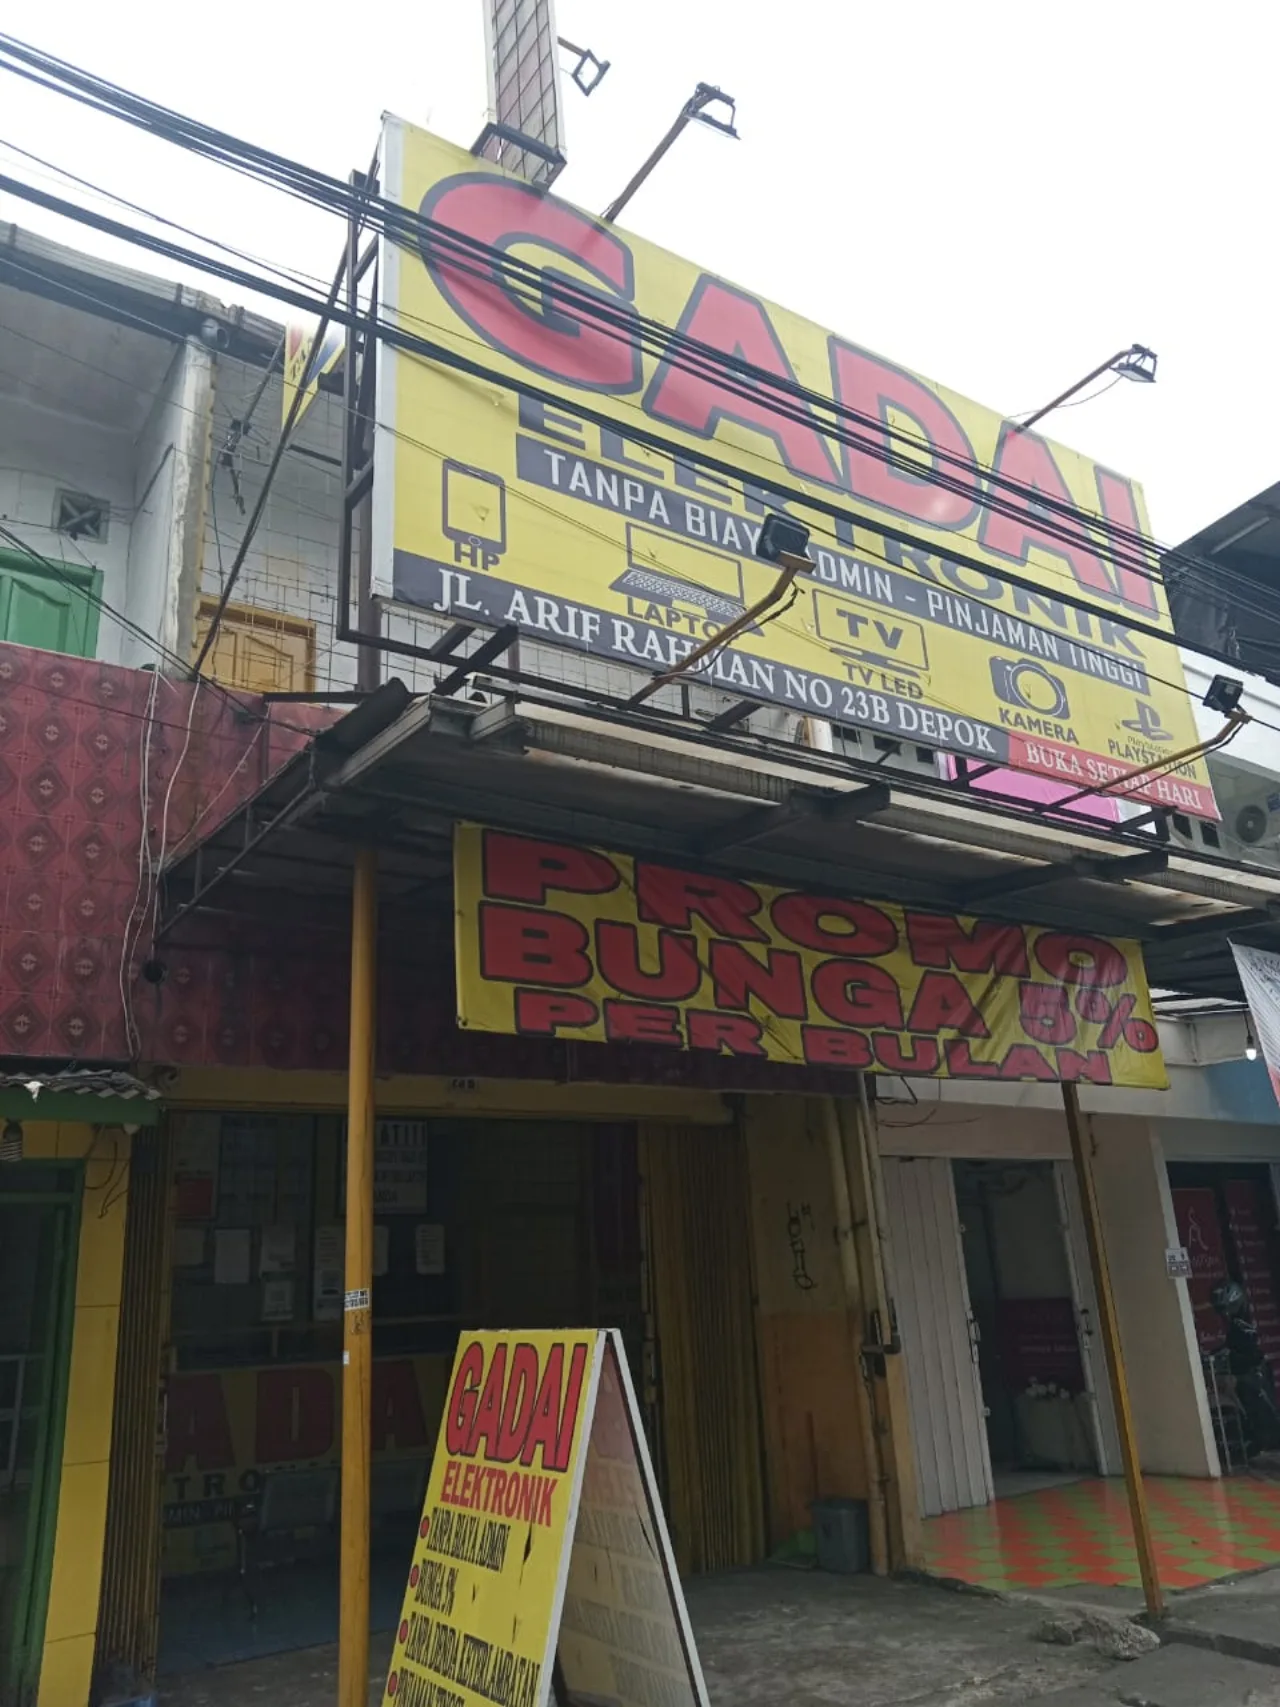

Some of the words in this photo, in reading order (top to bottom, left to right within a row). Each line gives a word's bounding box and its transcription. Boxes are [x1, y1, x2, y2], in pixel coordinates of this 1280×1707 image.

[419, 172, 1159, 620] GADAI
[453, 542, 501, 571] HP
[543, 449, 671, 525] TANPA
[684, 501, 764, 557] BIAY
[804, 547, 893, 603] DMIN
[926, 588, 1059, 661] PINJAMAN
[1068, 643, 1144, 689] TINGGI
[433, 568, 489, 616] JL.
[504, 589, 601, 643] ARIF
[611, 618, 776, 694] RAHMAN
[783, 669, 833, 710] NO
[842, 688, 889, 725] 23B
[896, 701, 998, 755] DEPOK
[627, 597, 741, 645] LAPTO
[835, 608, 904, 650] TV
[842, 662, 874, 685] TV
[881, 672, 924, 699] LED
[998, 707, 1080, 746] KAMERA
[1025, 742, 1084, 776] BUKA
[1156, 780, 1204, 810] HARI
[482, 830, 1128, 988] PROMO
[478, 899, 991, 1039] BUNGA
[1018, 980, 1159, 1053] 5%
[515, 988, 768, 1058] PER
[802, 1025, 1112, 1085] BULAN
[445, 1341, 588, 1472] GADAI
[440, 1459, 557, 1527] ELEKTRONIK
